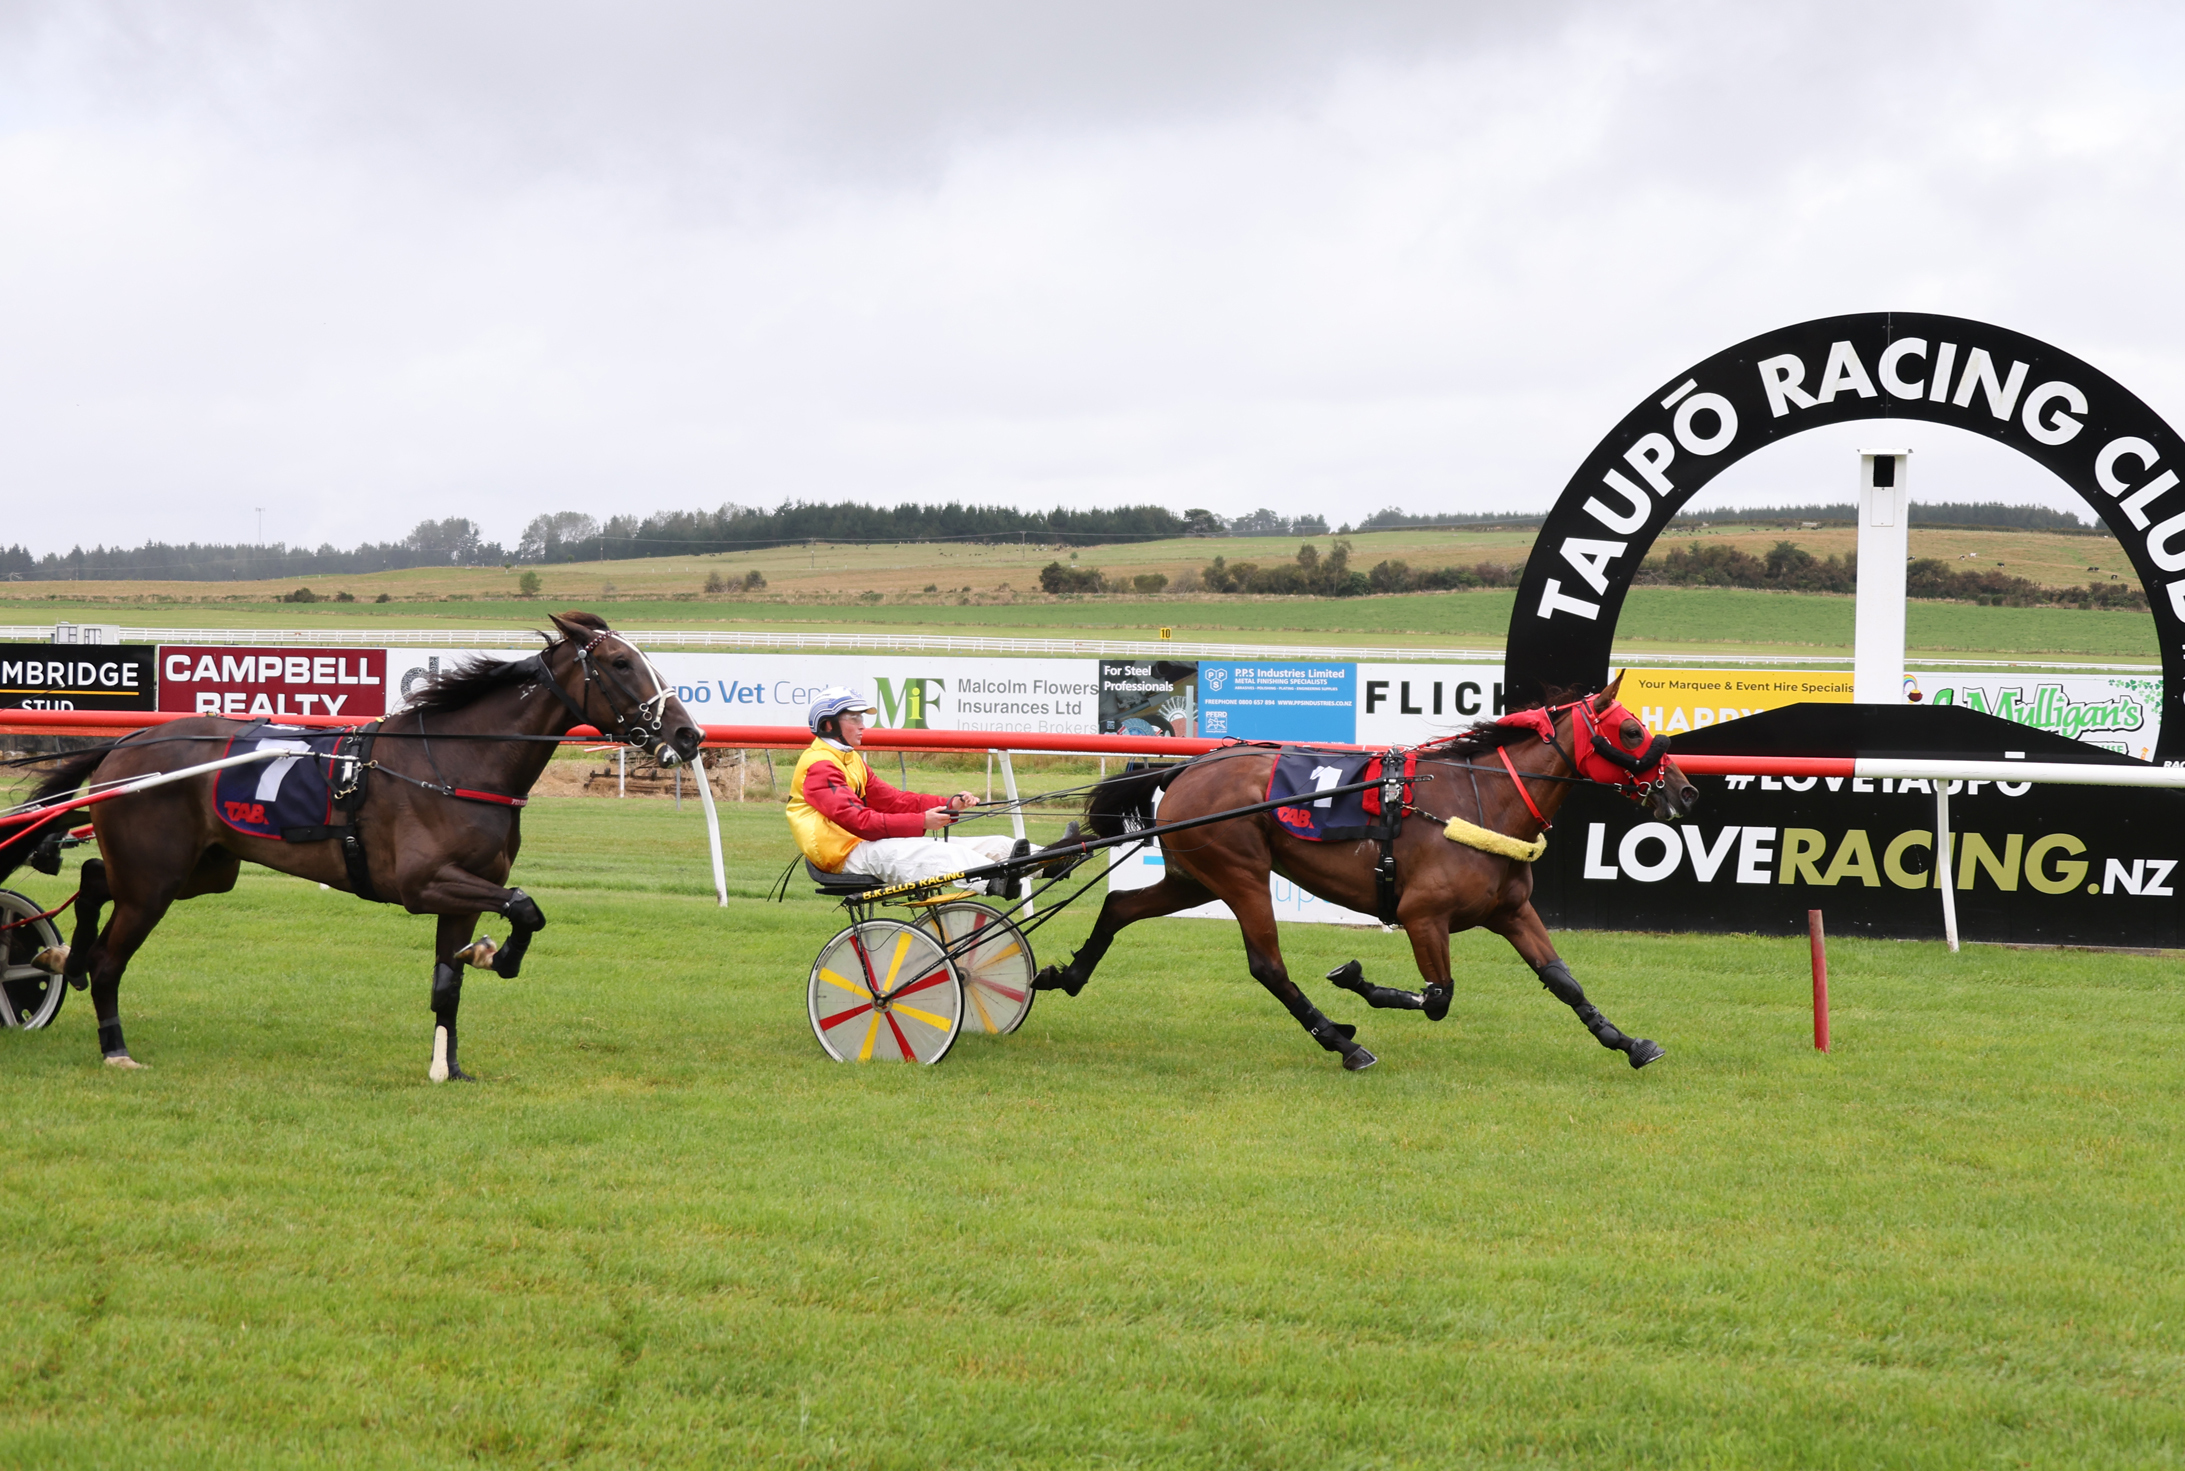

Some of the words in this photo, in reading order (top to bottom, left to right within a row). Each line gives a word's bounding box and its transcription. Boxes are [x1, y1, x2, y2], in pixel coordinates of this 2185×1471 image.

[1537, 379, 1738, 621] TAUPŌ
[1757, 337, 2089, 446] RACING
[1161, 628, 1171, 639] 10
[2, 660, 139, 687] MBRIDGE
[165, 654, 380, 685] CAMPBELL
[1103, 665, 1123, 677] For
[1124, 665, 1152, 677] Steel
[1257, 668, 1306, 678] Industries
[1308, 669, 1345, 679] Limited
[717, 680, 766, 704] Vet
[958, 678, 1027, 695] Malcolm
[1033, 679, 1099, 696] Flowers
[1103, 680, 1175, 693] Professionals
[1639, 680, 1666, 689] Your
[1669, 681, 1721, 691] Marquee
[1725, 682, 1733, 690] &
[1737, 682, 1770, 691] Event
[1774, 683, 1798, 692] Hire
[1801, 683, 1854, 694] Specialis
[195, 691, 348, 716] REALTY
[958, 699, 1050, 715] Insurances
[1055, 700, 1082, 716] Ltd
[957, 719, 1034, 733] Insurance
[1038, 720, 1099, 735] Brokers
[255, 737, 312, 802] 7
[1309, 765, 1343, 808] 1
[918, 871, 966, 887] RACING
